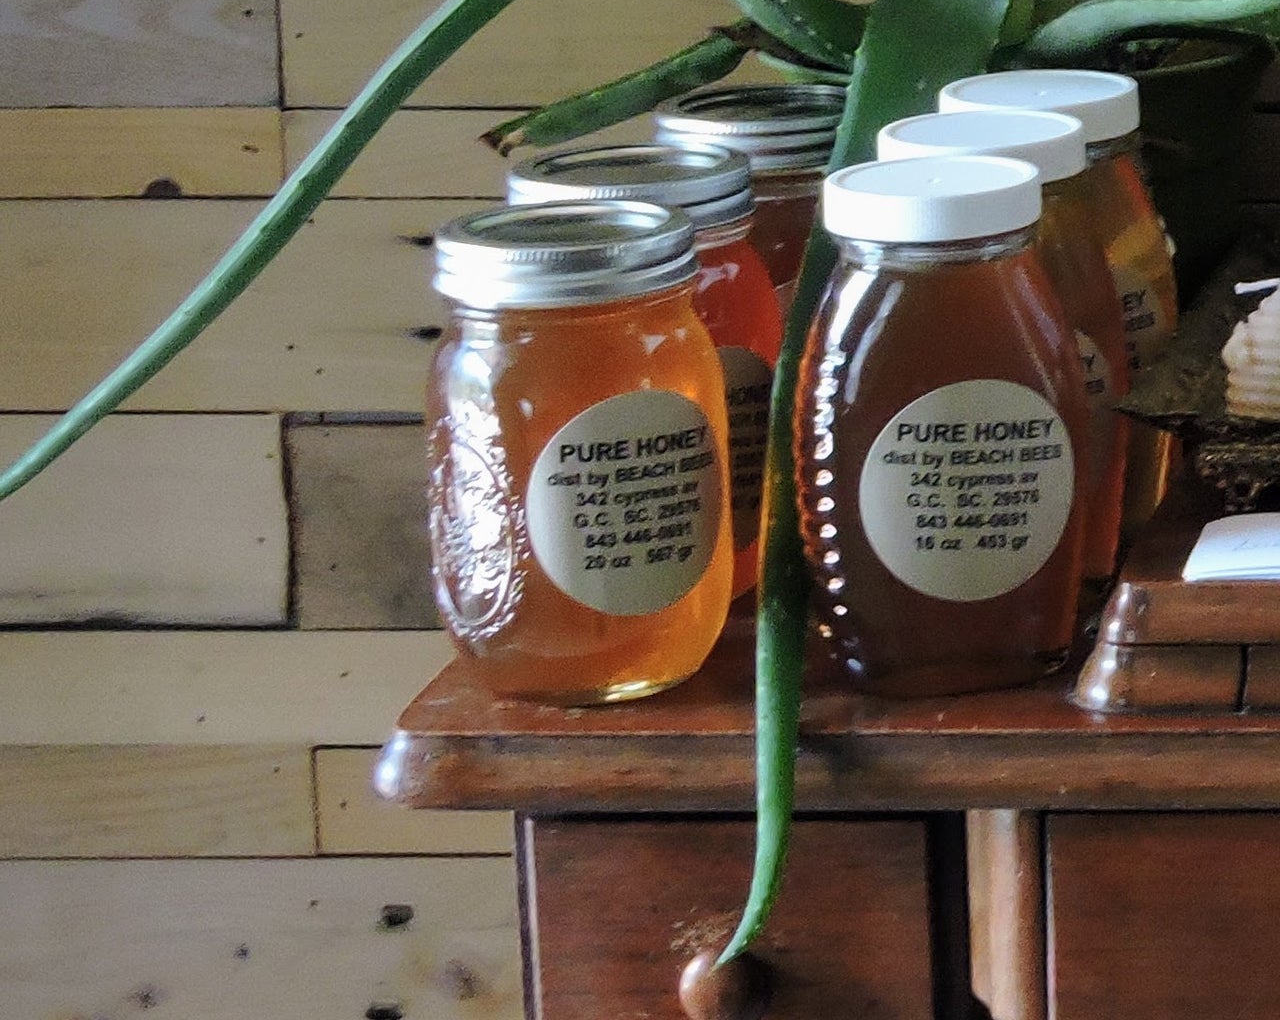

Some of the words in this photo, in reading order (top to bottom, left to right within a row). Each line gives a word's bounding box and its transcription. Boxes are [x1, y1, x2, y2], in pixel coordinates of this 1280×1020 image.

[897, 423, 967, 443] PURE
[973, 419, 1055, 443] HONEY
[559, 440, 630, 463] PURE
[637, 425, 707, 458] HONEY
[922, 453, 944, 468] by
[950, 450, 1015, 465] BEACH
[1020, 444, 1062, 462] BEES
[587, 474, 609, 488] by
[615, 461, 675, 484] BEACH
[940, 538, 963, 550] oz
